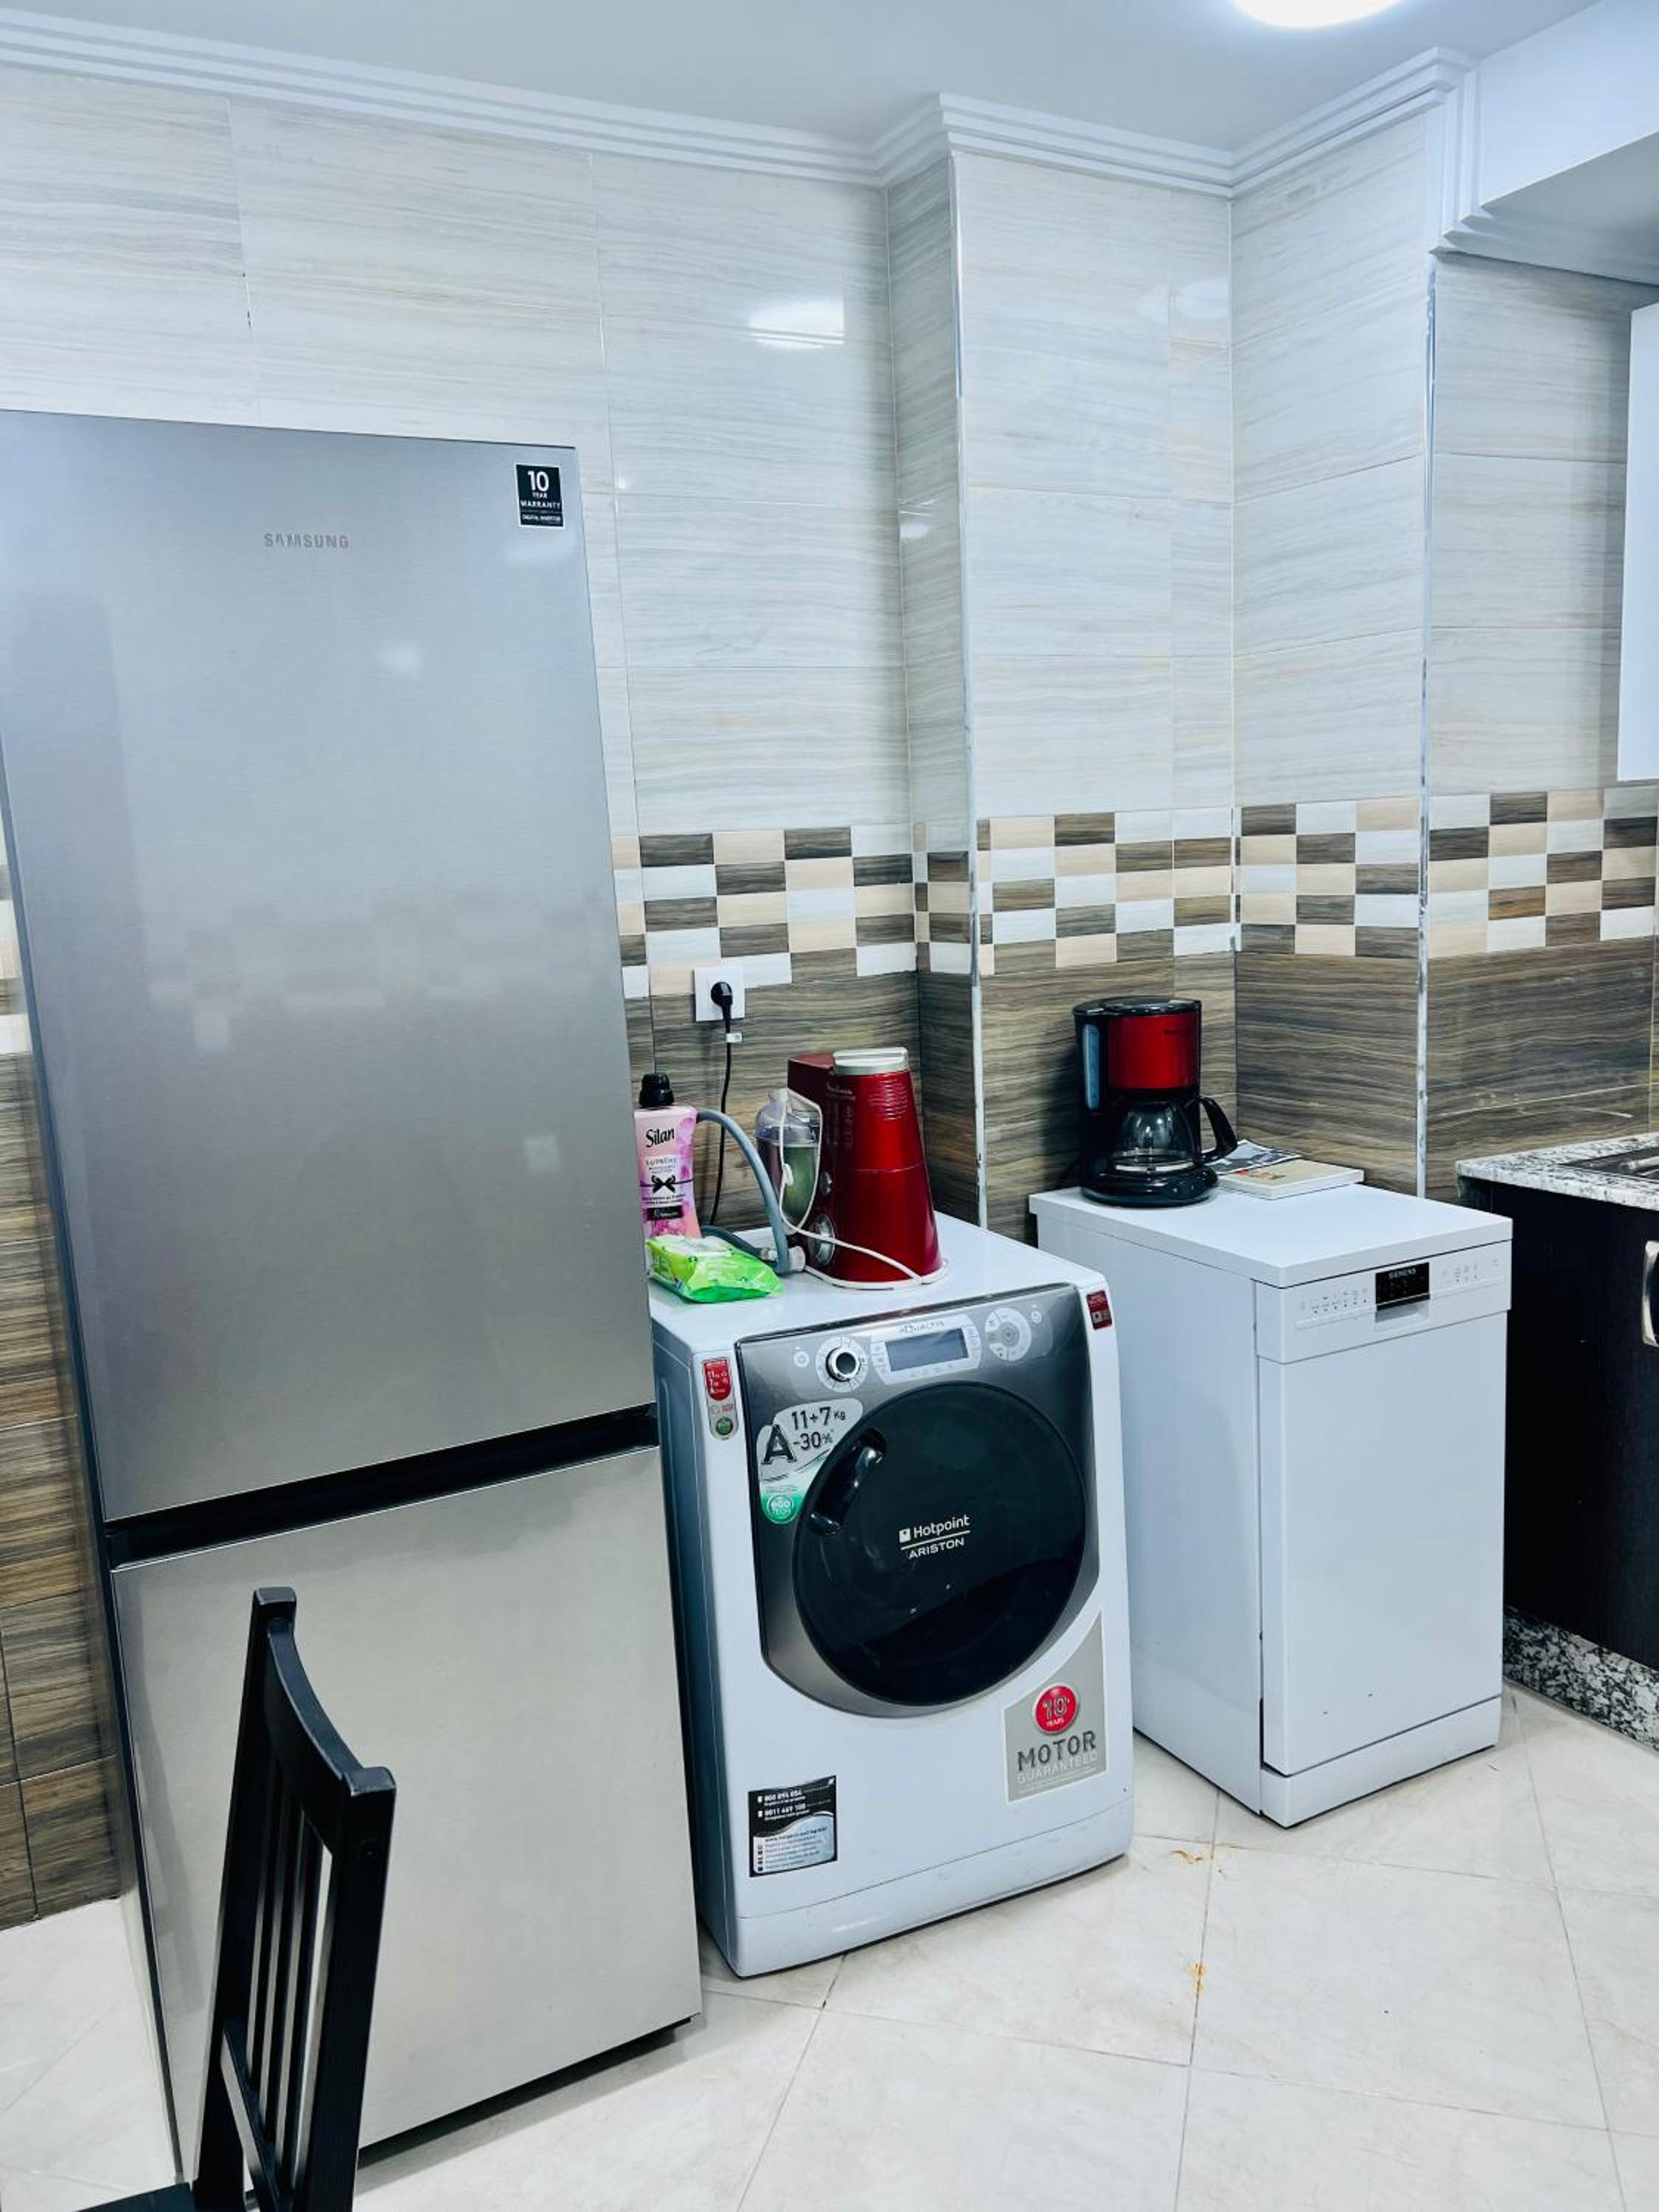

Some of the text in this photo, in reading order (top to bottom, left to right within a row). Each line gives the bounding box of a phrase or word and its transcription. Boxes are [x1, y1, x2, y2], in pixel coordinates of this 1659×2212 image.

[527, 470, 549, 492] 10
[520, 500, 561, 509] WARRANTY
[263, 532, 349, 548] SAMSUNG
[645, 1127, 675, 1148] Silan
[760, 1423, 798, 1466] A
[913, 1514, 970, 1540] Hotpoint
[908, 1537, 964, 1560] ARISTON
[1017, 1731, 1096, 1771] MOTOR
